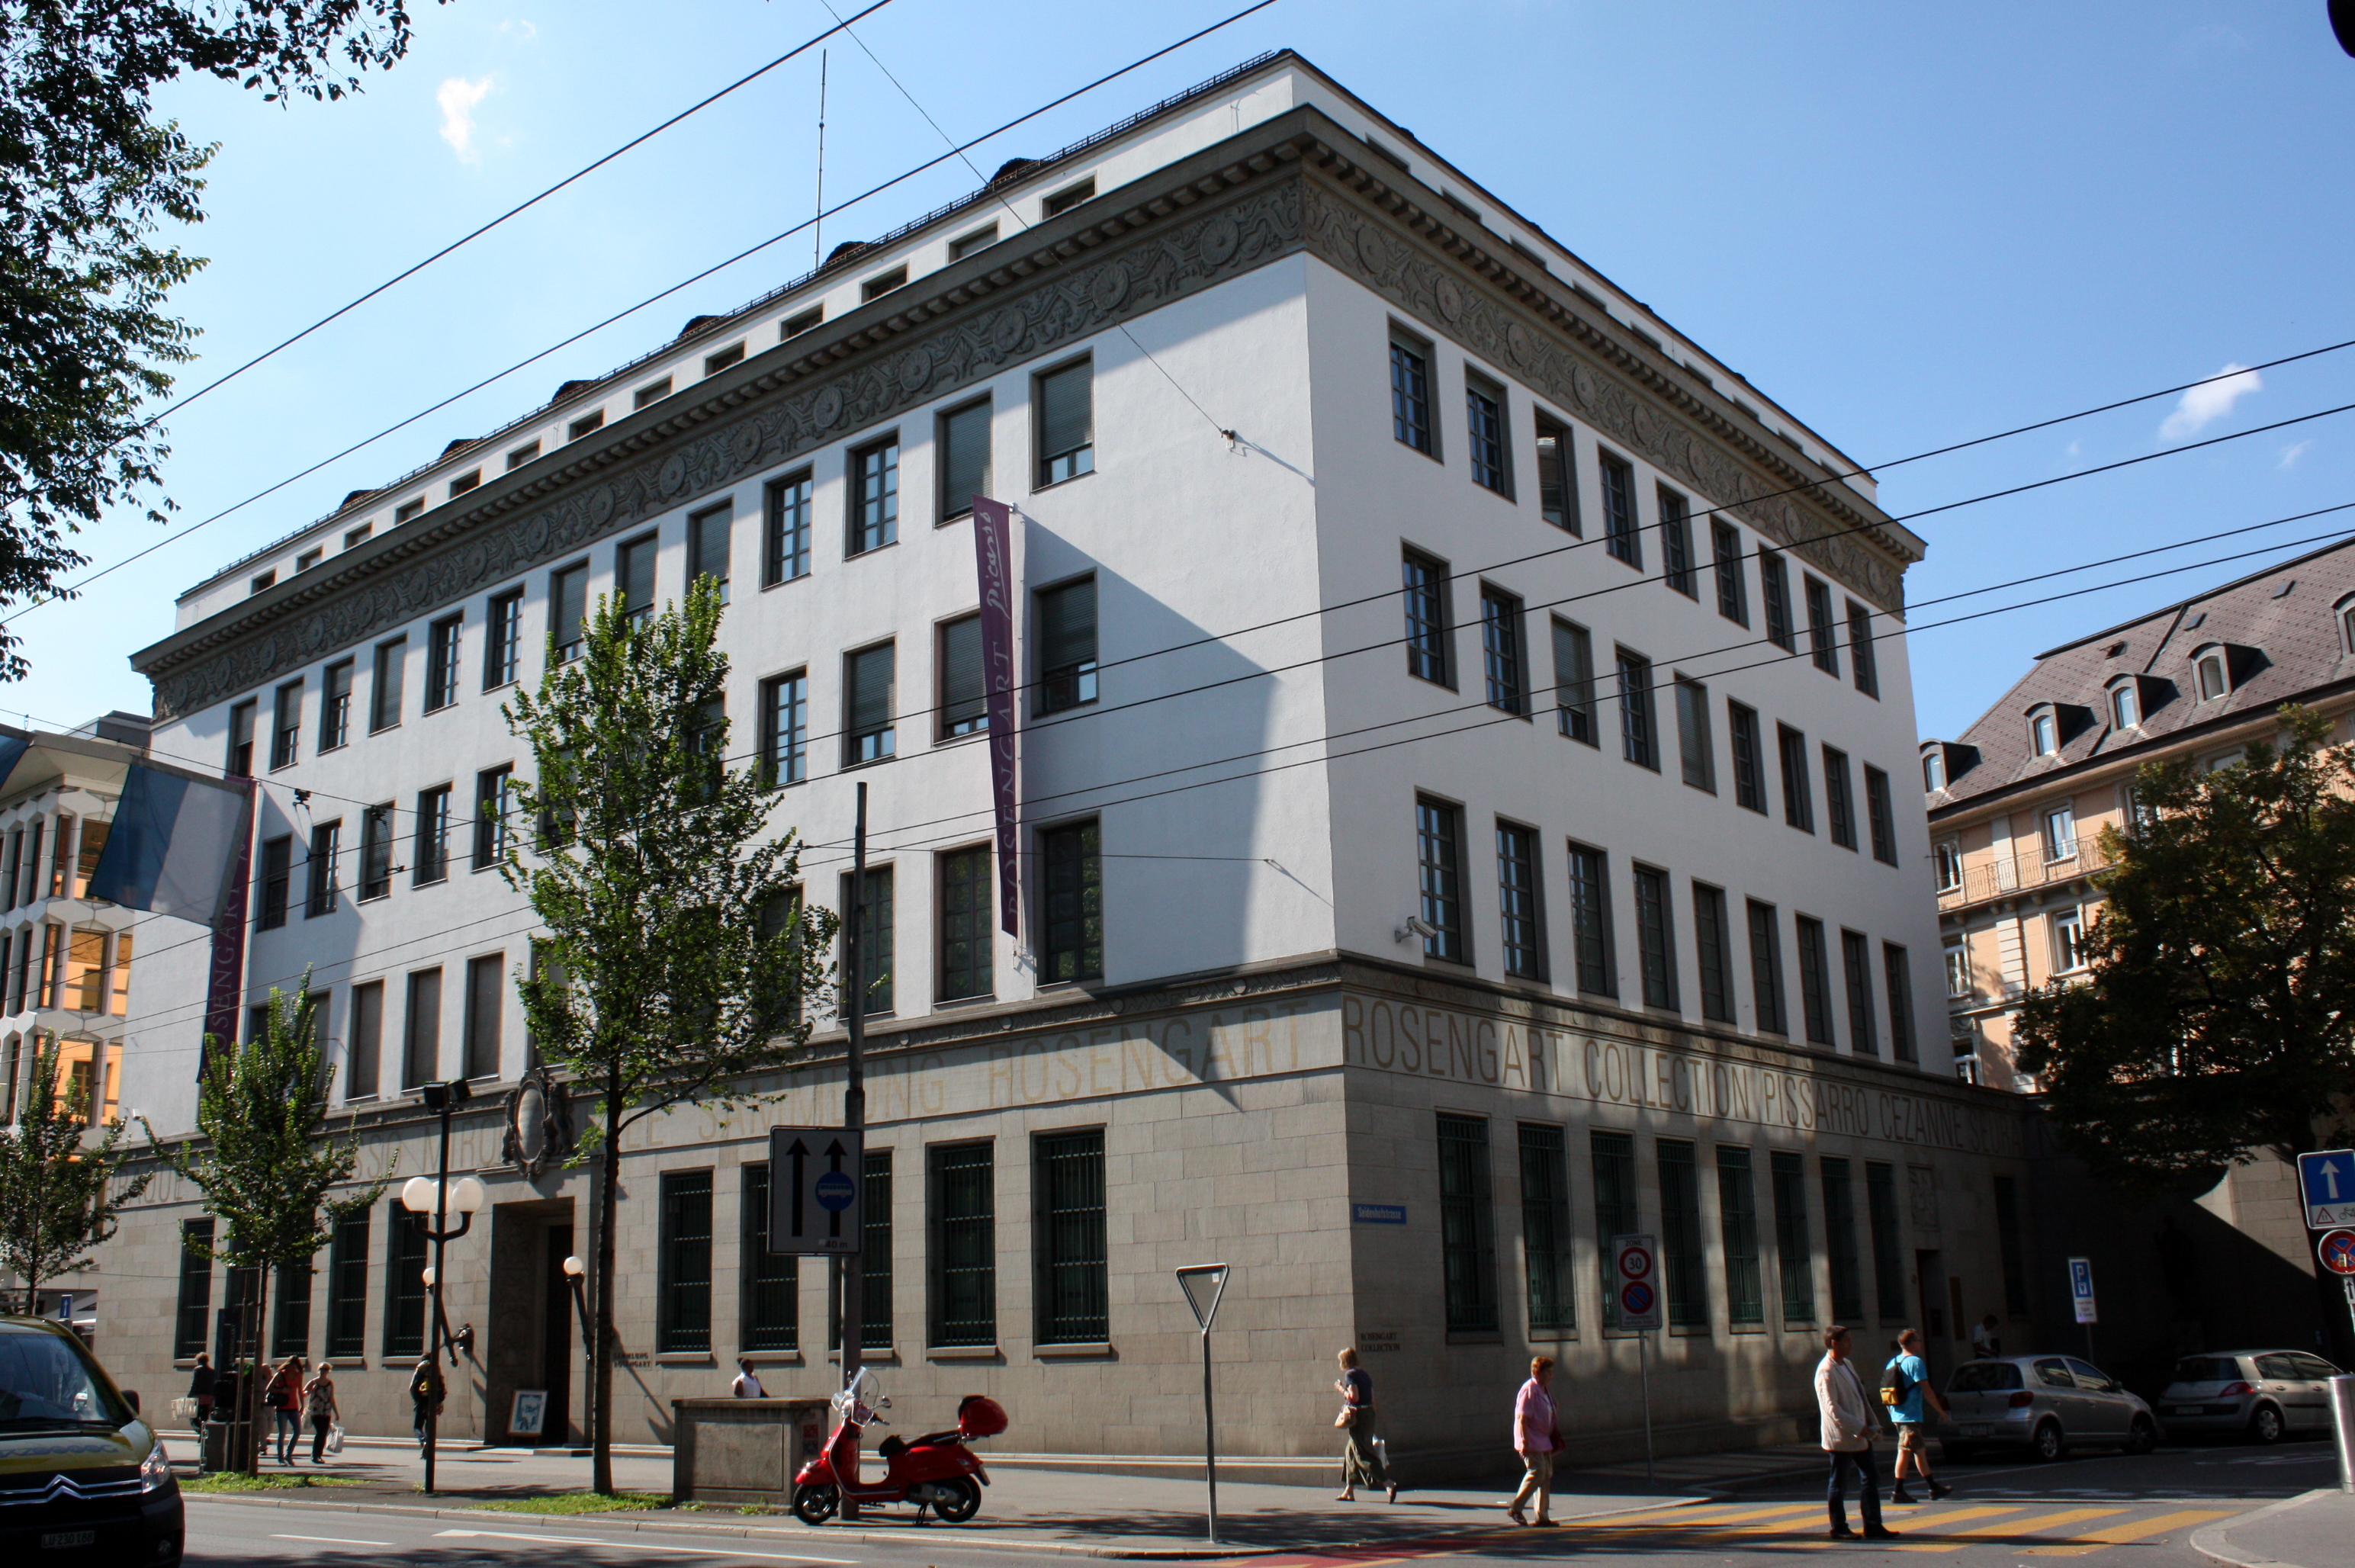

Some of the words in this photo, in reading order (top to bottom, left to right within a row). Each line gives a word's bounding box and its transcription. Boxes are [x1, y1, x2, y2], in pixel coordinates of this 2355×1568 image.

[993, 641, 1019, 914] ROSENGART
[210, 888, 240, 1053] OSENGAR
[989, 1000, 1309, 1108] ROSENGART
[1342, 994, 1564, 1092] ROSENGART
[1583, 1039, 1750, 1120] COLLECTION
[1763, 1072, 1870, 1136] PISSARRO
[1878, 1091, 1964, 1149] CEZANNE
[1358, 1207, 1402, 1219] Seidenhofstrasse
[825, 1240, 837, 1248] 40
[1629, 1258, 1642, 1270] 30
[2075, 1264, 2085, 1281] P
[1361, 1332, 1398, 1341] ROSENGART
[1361, 1343, 1400, 1352] COLLECTION
